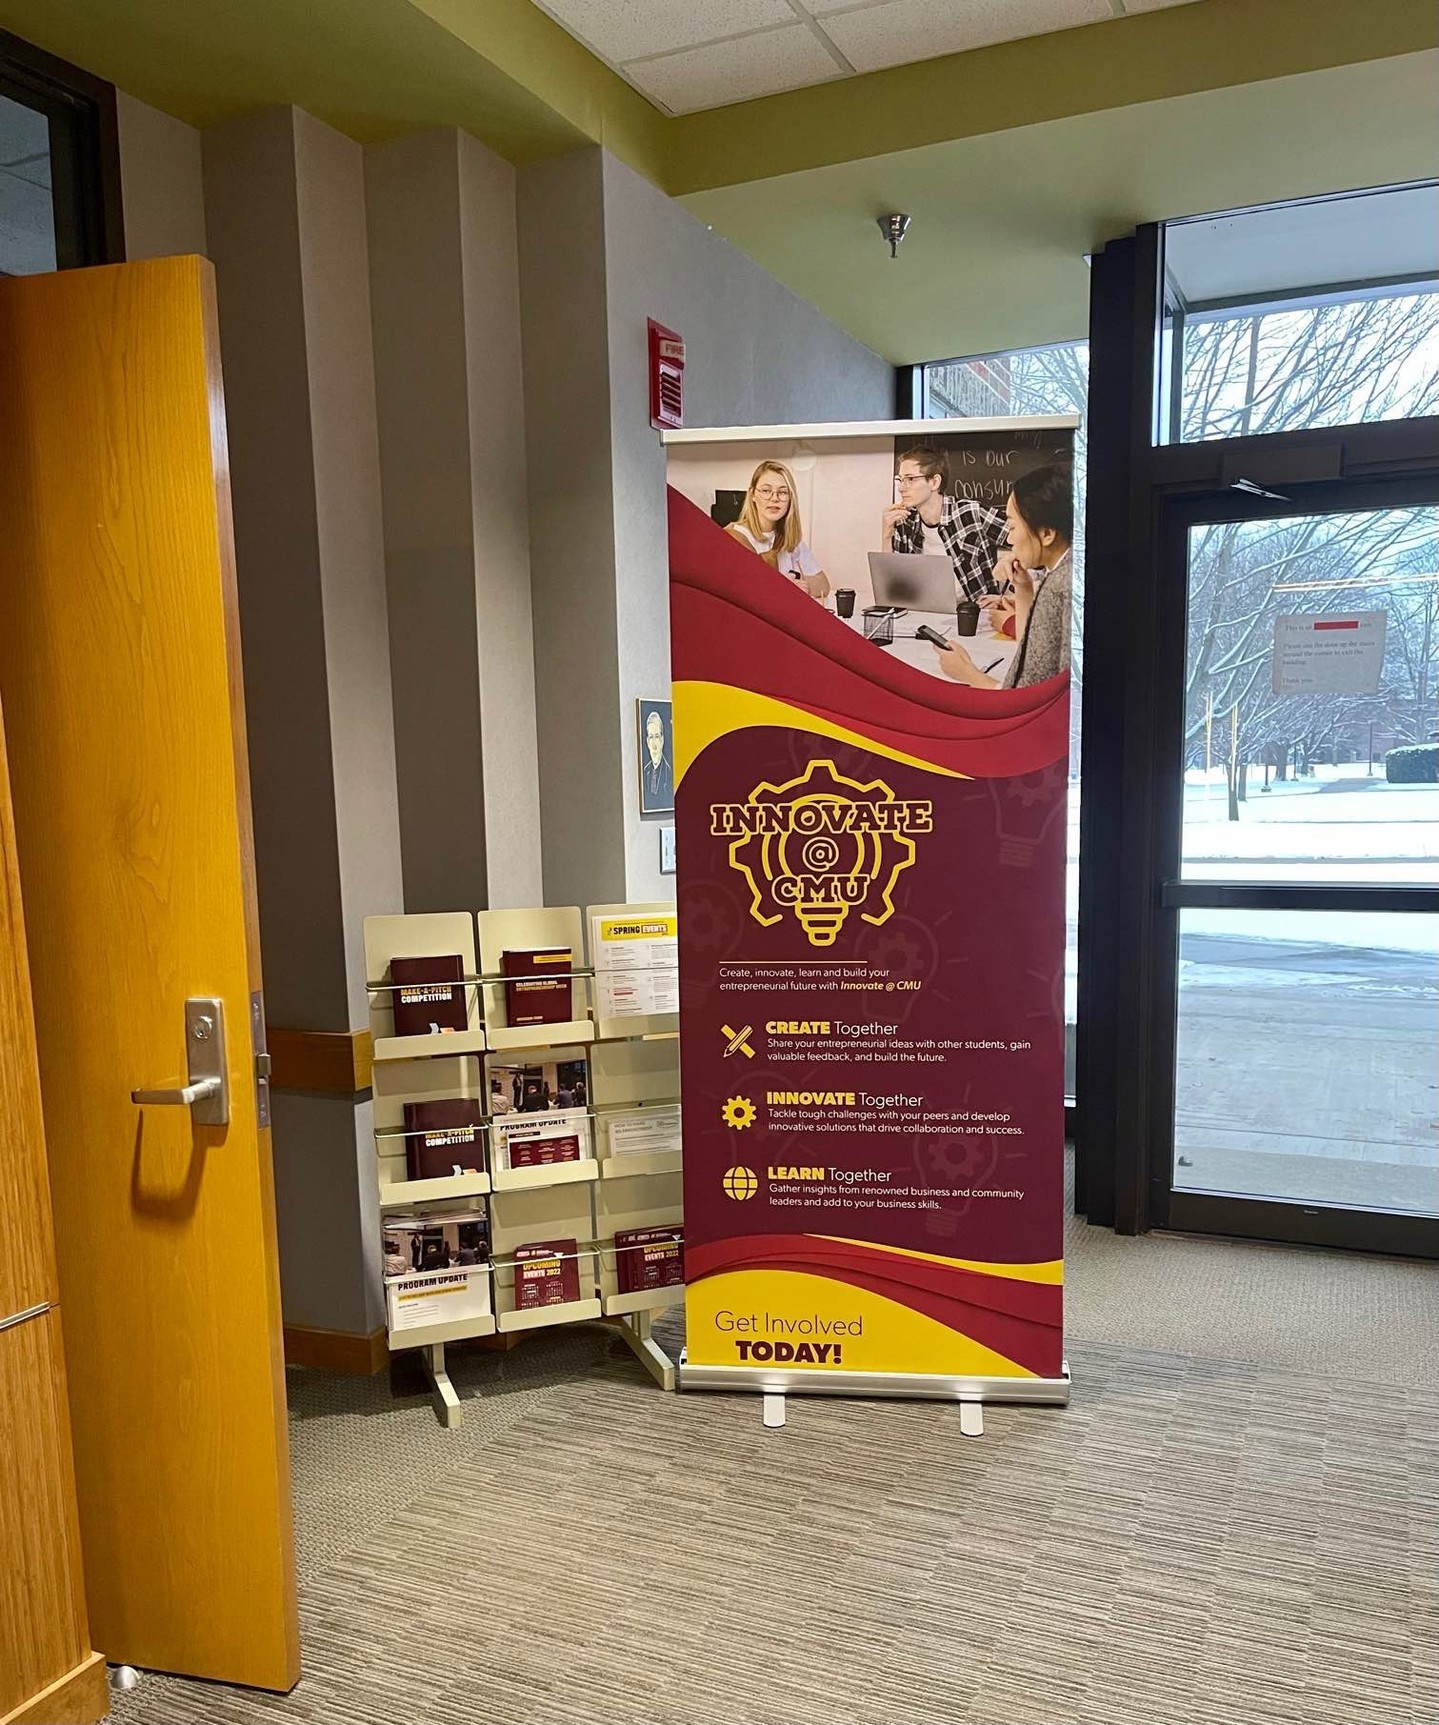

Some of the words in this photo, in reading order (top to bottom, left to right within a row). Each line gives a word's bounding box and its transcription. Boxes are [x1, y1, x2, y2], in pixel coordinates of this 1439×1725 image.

[666, 343, 684, 356] FIRE
[711, 801, 933, 835] INNOVATE
[802, 836, 839, 872] @
[772, 874, 870, 906] CMU
[613, 925, 641, 936] SPRING
[642, 924, 666, 934] EVENTS
[719, 968, 753, 978] Create,
[755, 968, 796, 978] innovate,
[798, 968, 822, 977] learn
[823, 968, 841, 978] and
[843, 968, 867, 978] build
[868, 969, 890, 979] your
[720, 980, 790, 992] entrepreneurial
[790, 980, 817, 991] future
[818, 980, 838, 990] with
[840, 981, 884, 991] Innovate
[885, 982, 896, 992] @
[896, 981, 922, 990] CMU
[401, 992, 453, 1004] COMPETITION
[766, 1021, 830, 1035] CREATE
[834, 1021, 898, 1038] Together
[767, 1038, 793, 1048] Share
[794, 1040, 815, 1050] your
[816, 1039, 887, 1050] entrepreneurial
[889, 1040, 914, 1049] ideas
[915, 1040, 936, 1049] with
[937, 1040, 962, 1049] other
[964, 1040, 1008, 1050] students,
[1010, 1040, 1031, 1052] gain
[767, 1052, 806, 1061] valuable
[806, 1052, 853, 1062] feedback,
[854, 1052, 872, 1062] and
[874, 1052, 898, 1062] build
[900, 1052, 916, 1062] the
[917, 1052, 947, 1062] future.
[766, 1092, 856, 1106] INNOVATE
[858, 1092, 924, 1110] Together
[768, 1108, 797, 1118] Tackle
[798, 1110, 826, 1120] tough
[828, 1110, 877, 1120] challenges
[878, 1110, 898, 1120] with
[900, 1112, 920, 1122] your
[923, 1112, 950, 1121] peers
[950, 1112, 968, 1120] and
[970, 1112, 1010, 1123] develop
[768, 1122, 814, 1131] innovative
[816, 1122, 857, 1132] solutions
[858, 1122, 876, 1132] that
[878, 1124, 902, 1132] drive
[902, 1124, 964, 1134] collaboration
[966, 1125, 984, 1134] and
[986, 1126, 1024, 1135] success.
[426, 1134, 474, 1146] COMPETITION
[767, 1166, 824, 1180] LEARN
[828, 1168, 892, 1184] Together
[768, 1184, 801, 1193] Gather
[802, 1184, 837, 1196] insights
[838, 1184, 860, 1194] from
[861, 1186, 908, 1196] renowned
[910, 1186, 950, 1196] business
[952, 1188, 970, 1197] and
[972, 1188, 1024, 1200] community
[770, 1196, 802, 1206] leaders
[804, 1198, 821, 1206] and
[822, 1198, 842, 1207] add
[843, 1198, 853, 1207] to
[854, 1200, 875, 1209] your
[876, 1199, 916, 1209] business
[918, 1200, 942, 1210] skills.
[644, 1252, 665, 1261] EVENTS
[666, 1250, 679, 1258] 2022
[523, 1270, 546, 1280] EVENTS
[546, 1268, 561, 1276] 2022
[398, 1278, 437, 1291] PROGRAM
[438, 1273, 468, 1284] UPDATE
[715, 1310, 758, 1332] Get
[766, 1312, 863, 1336] Involved
[735, 1340, 842, 1365] TODAY!
